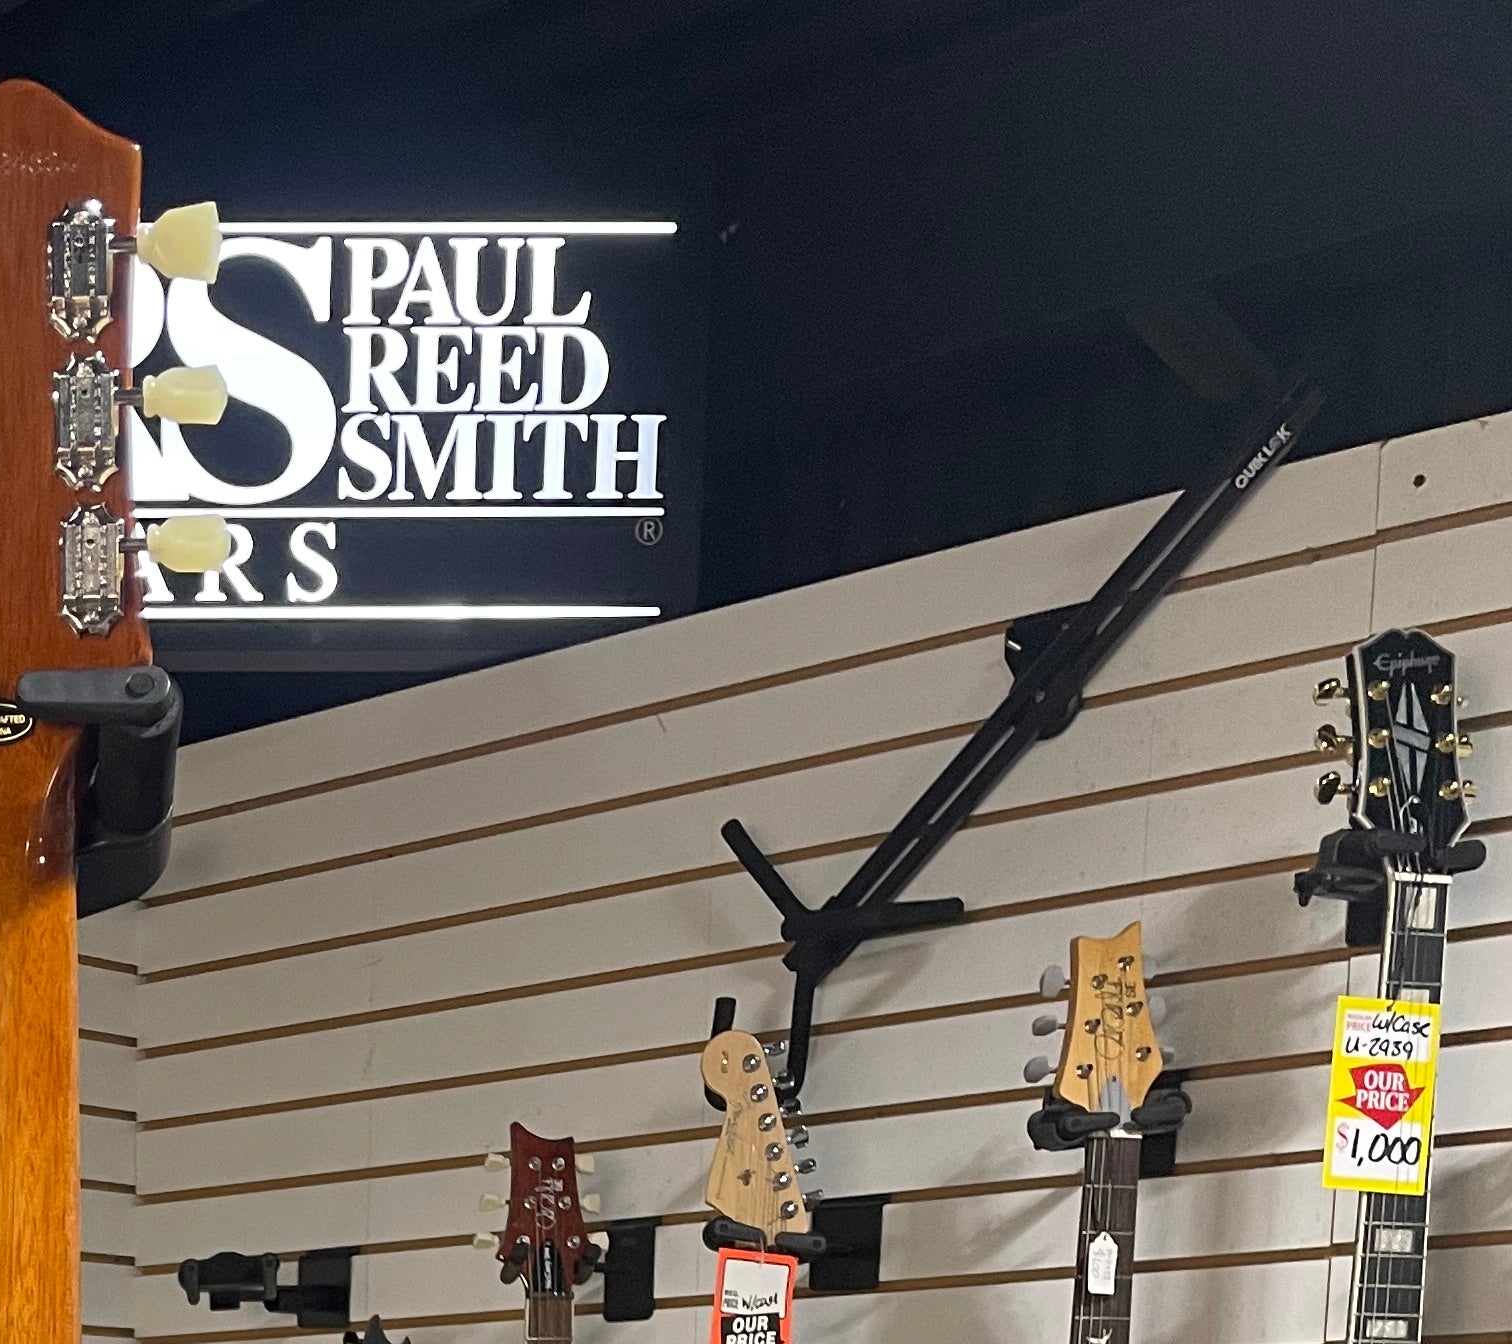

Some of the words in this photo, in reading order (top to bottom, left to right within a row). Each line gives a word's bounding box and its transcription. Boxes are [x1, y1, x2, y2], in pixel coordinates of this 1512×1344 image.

[342, 237, 592, 325] PAUL
[341, 326, 610, 413] REED
[338, 412, 667, 500] SMITH
[1355, 1089, 1410, 1112] PRICE
[1363, 1069, 1405, 1092] OUR
[732, 1315, 769, 1333] OUR
